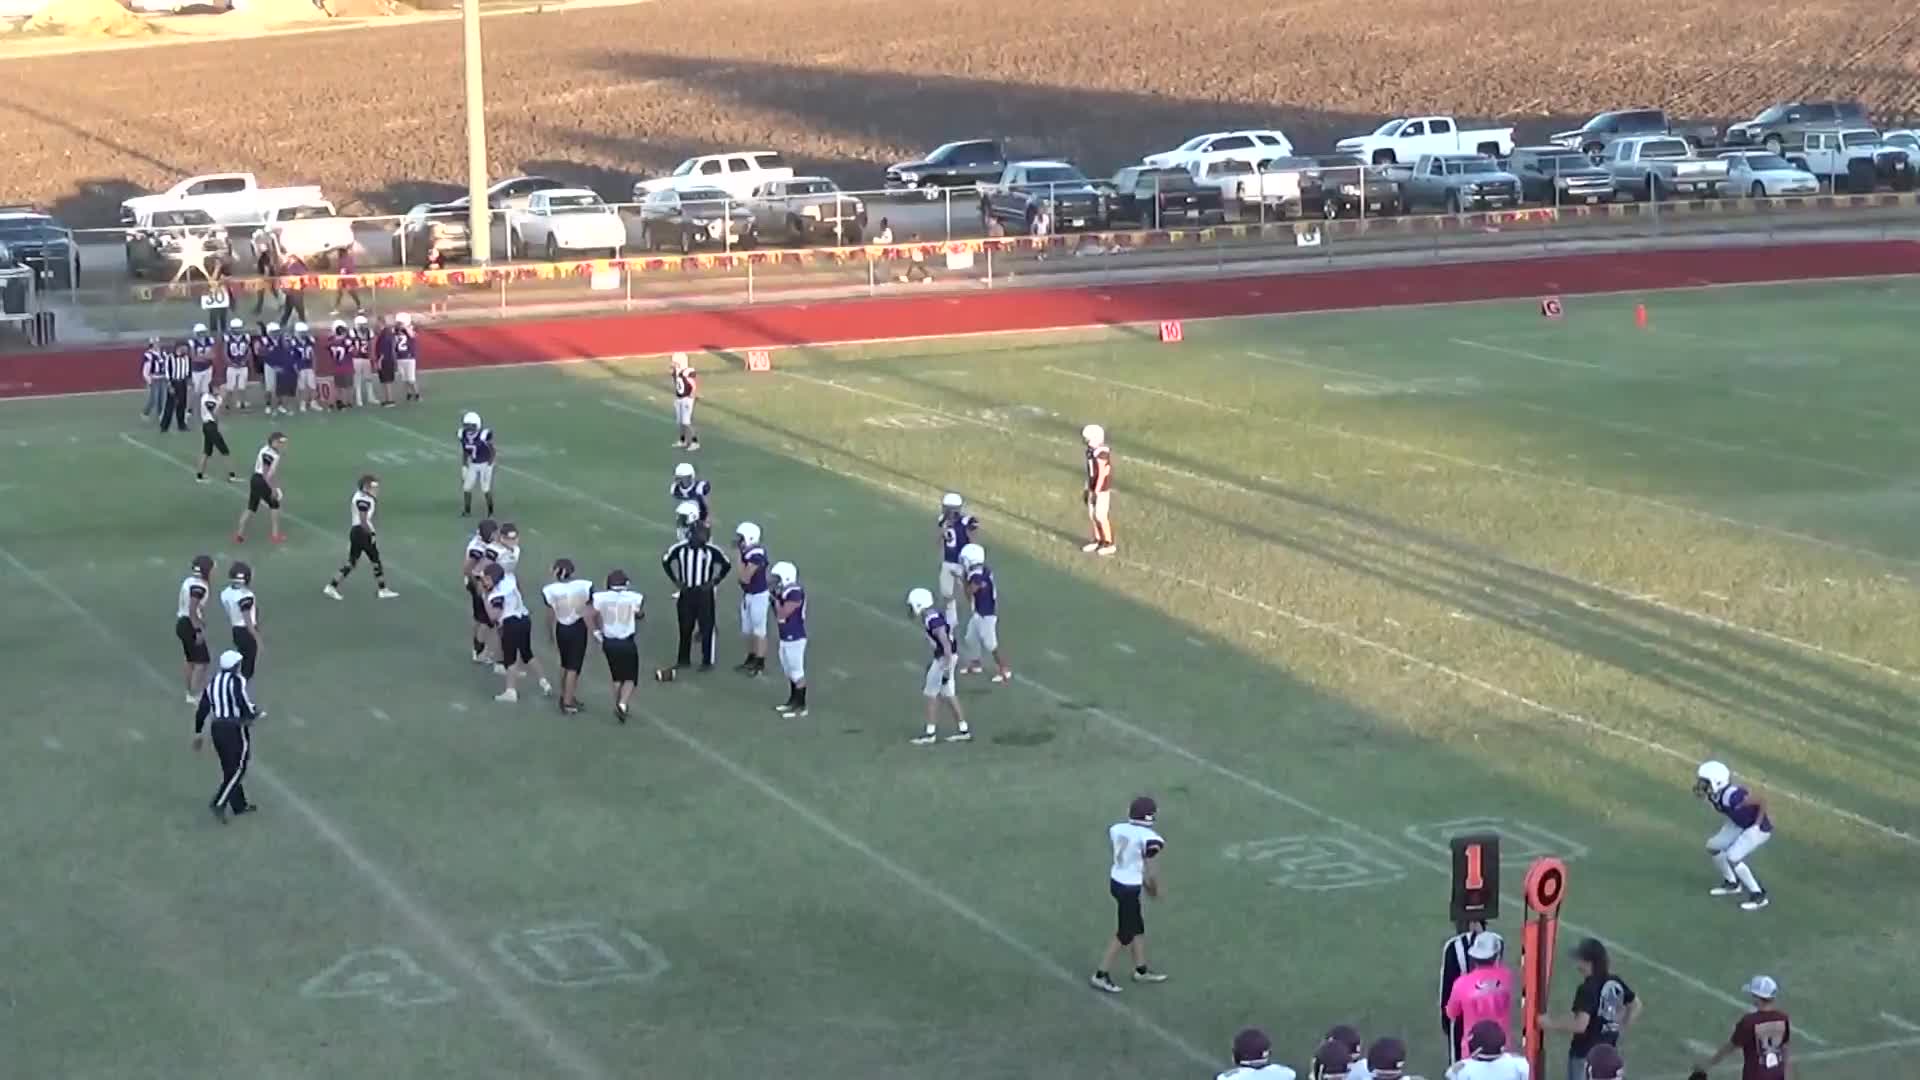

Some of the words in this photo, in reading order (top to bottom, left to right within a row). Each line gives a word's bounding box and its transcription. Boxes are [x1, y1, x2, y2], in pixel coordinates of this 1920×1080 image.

[205, 288, 225, 306] 30
[1547, 300, 1560, 315] G
[1163, 322, 1178, 341] 10
[751, 351, 768, 369] 20
[465, 444, 477, 460] 7
[1464, 844, 1485, 890] 1
